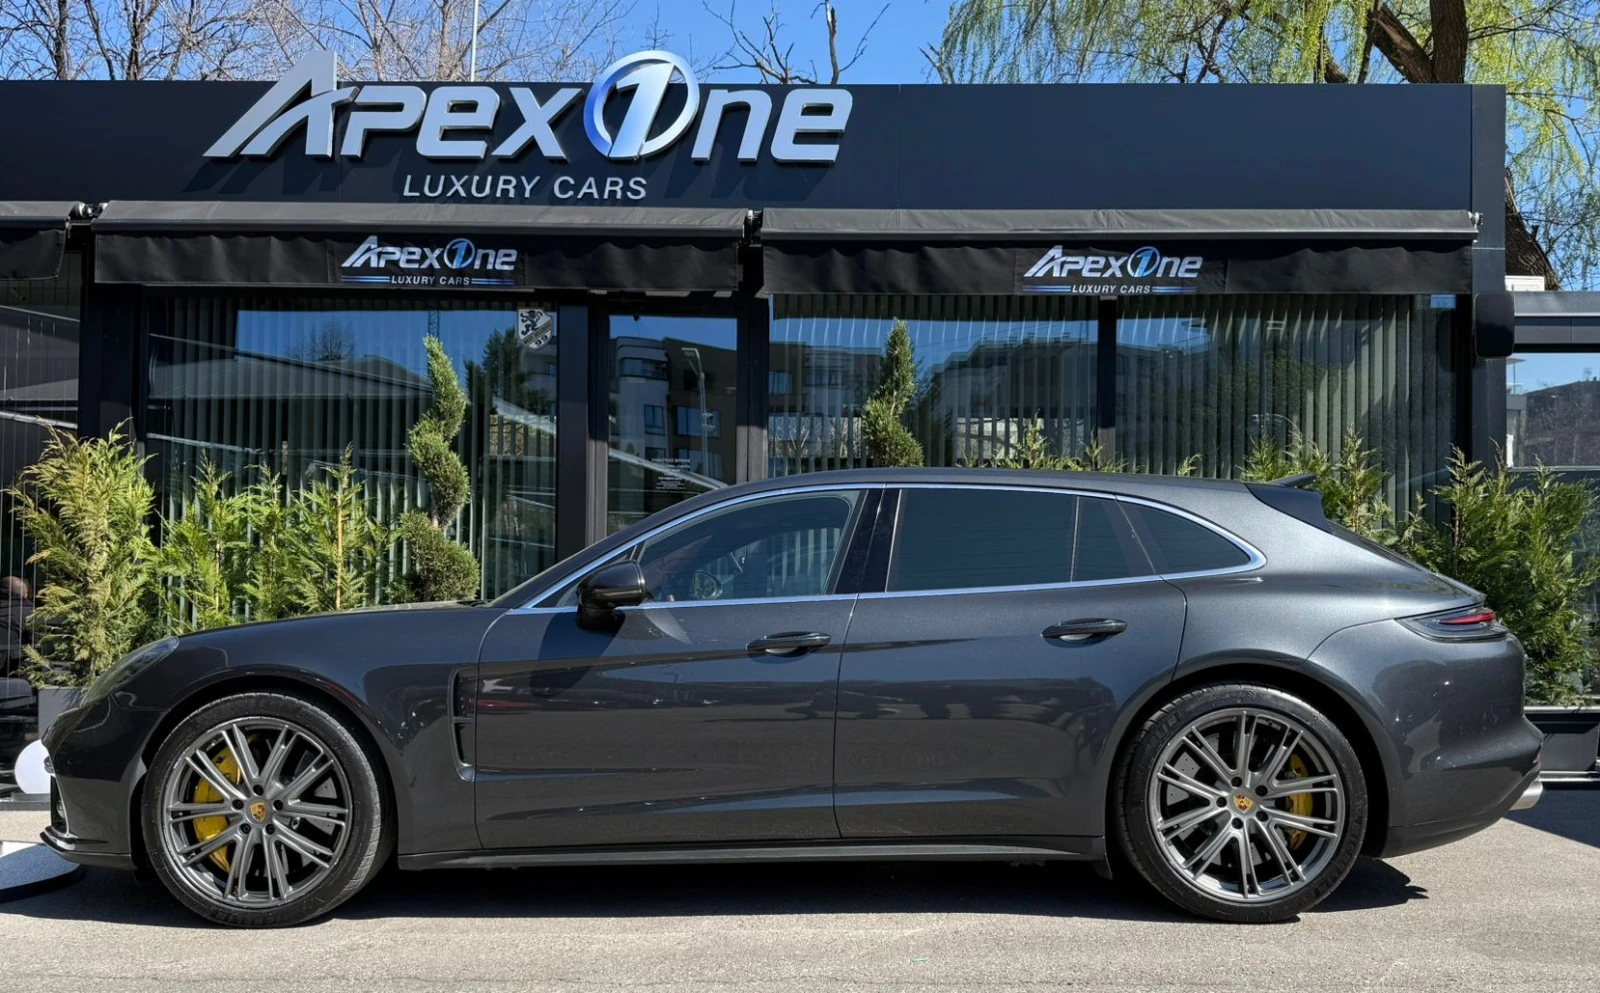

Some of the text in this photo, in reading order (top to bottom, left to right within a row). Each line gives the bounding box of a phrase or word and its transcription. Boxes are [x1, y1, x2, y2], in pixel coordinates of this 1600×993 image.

[403, 175, 647, 199] LUXURY CARS
[392, 276, 470, 285] LUXURY CARS
[1072, 285, 1151, 294] LUXURY CARS
